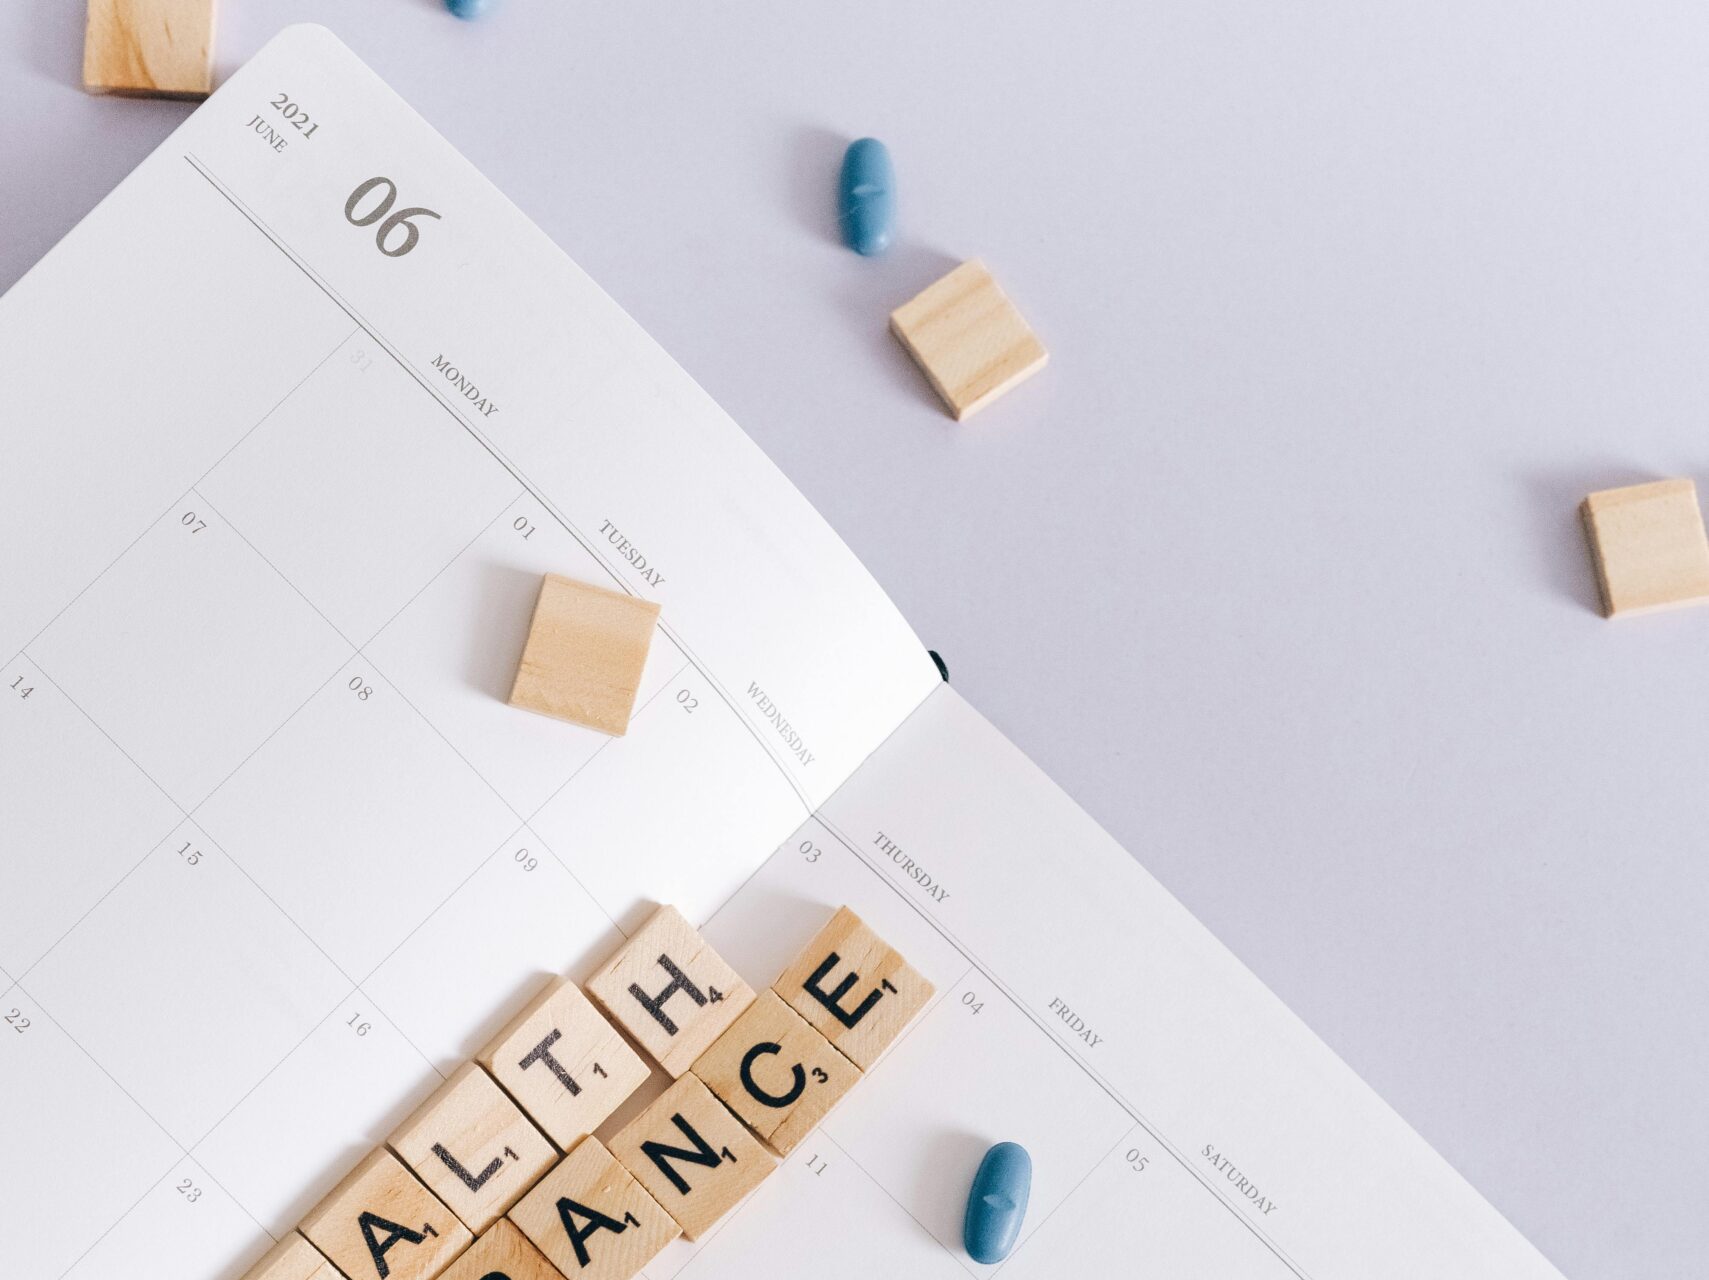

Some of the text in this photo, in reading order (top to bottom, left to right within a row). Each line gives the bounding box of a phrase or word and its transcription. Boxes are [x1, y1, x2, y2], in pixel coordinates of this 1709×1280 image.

[270, 92, 320, 140] 2021
[245, 114, 289, 153] JUNE
[343, 176, 442, 258] 06
[350, 348, 374, 374] 31
[430, 353, 500, 418] MONDAY
[180, 511, 207, 536] 07
[512, 516, 536, 541] 01
[598, 519, 666, 590] TUESDAY
[9, 674, 35, 701] 14
[348, 676, 374, 702] 08
[676, 689, 700, 714] 02
[745, 681, 816, 768] WEDNESDAY
[176, 842, 203, 868] 15
[514, 848, 539, 873] 09
[798, 839, 823, 865] 03
[872, 831, 951, 905] THURSDAY
[960, 991, 985, 1016] 04
[4, 1008, 31, 1036] 22
[346, 1012, 371, 1039] 16
[1047, 996, 1104, 1049] FRIDAY
[804, 1152, 828, 1177] 11
[1125, 1147, 1149, 1172] 05
[175, 1177, 203, 1204] 23
[1201, 1143, 1278, 1217] SATURDAY
